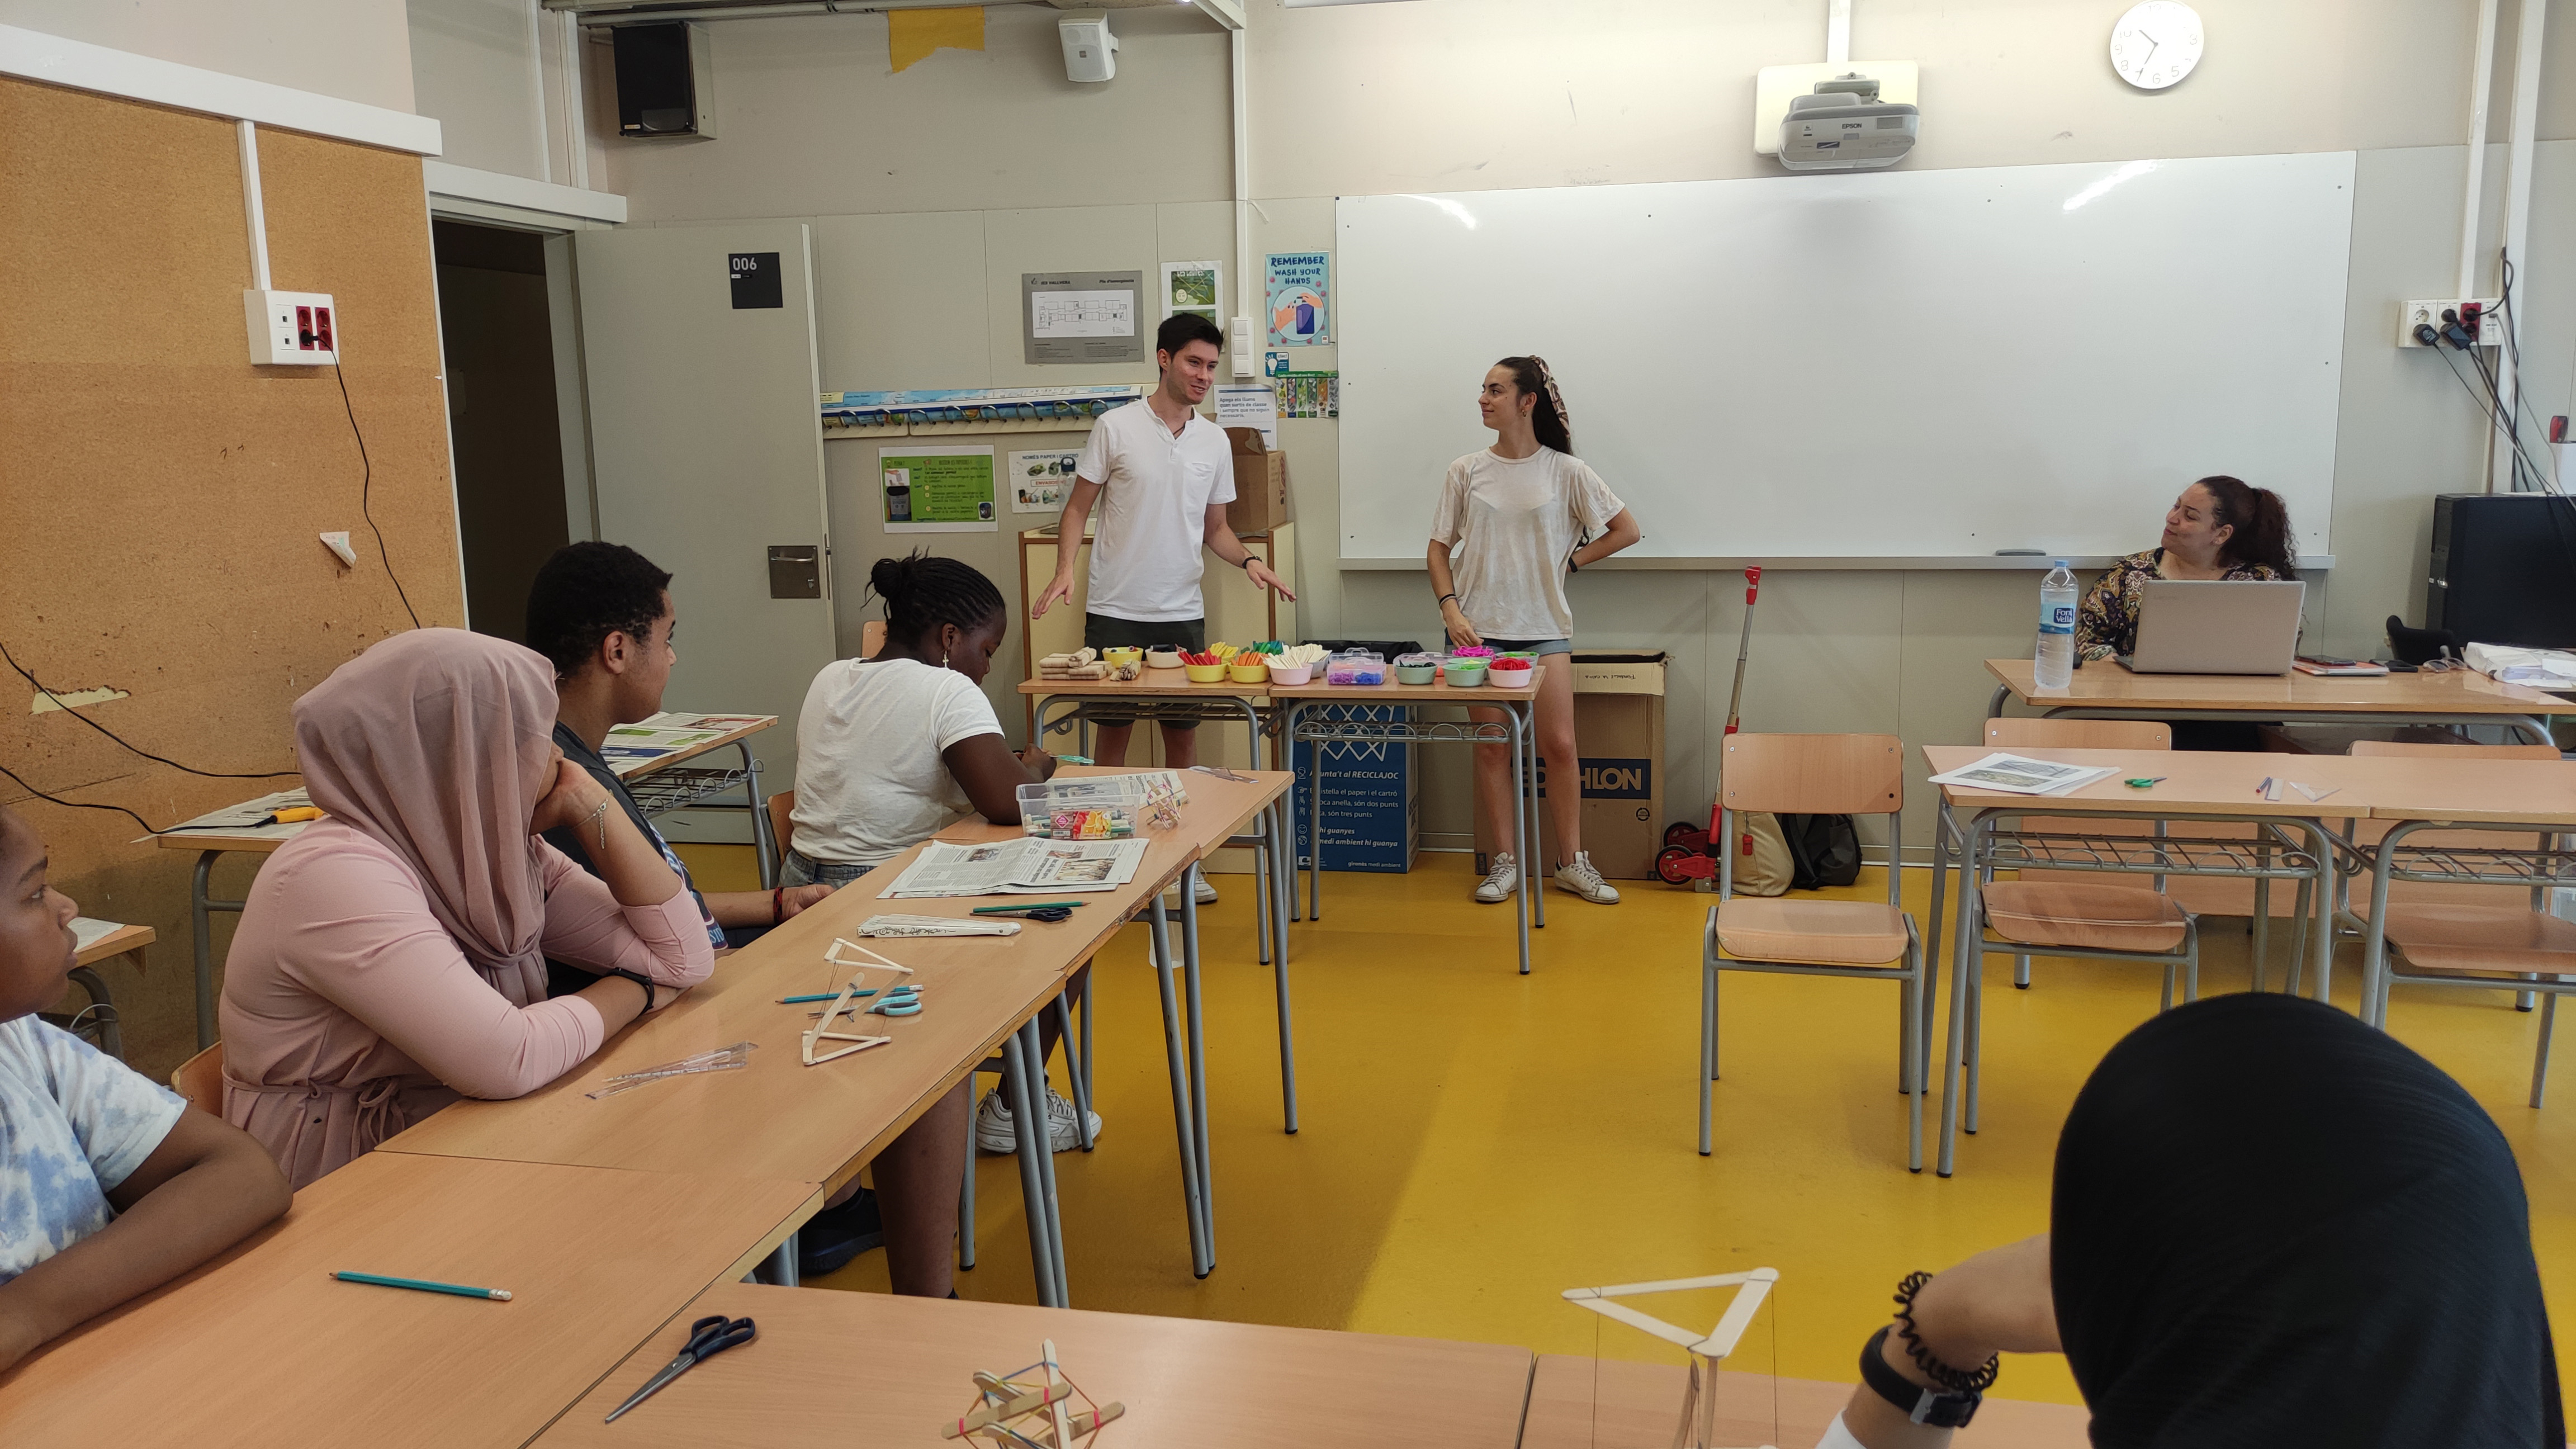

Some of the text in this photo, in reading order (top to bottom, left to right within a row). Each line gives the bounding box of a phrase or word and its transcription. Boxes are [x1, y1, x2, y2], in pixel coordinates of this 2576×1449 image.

[2171, 66, 2180, 77] 5
[2153, 73, 2161, 84] 6
[733, 257, 757, 271] 006
[1271, 256, 1324, 267] REMEMBER
[1352, 771, 1399, 779] RECICLAJOC
